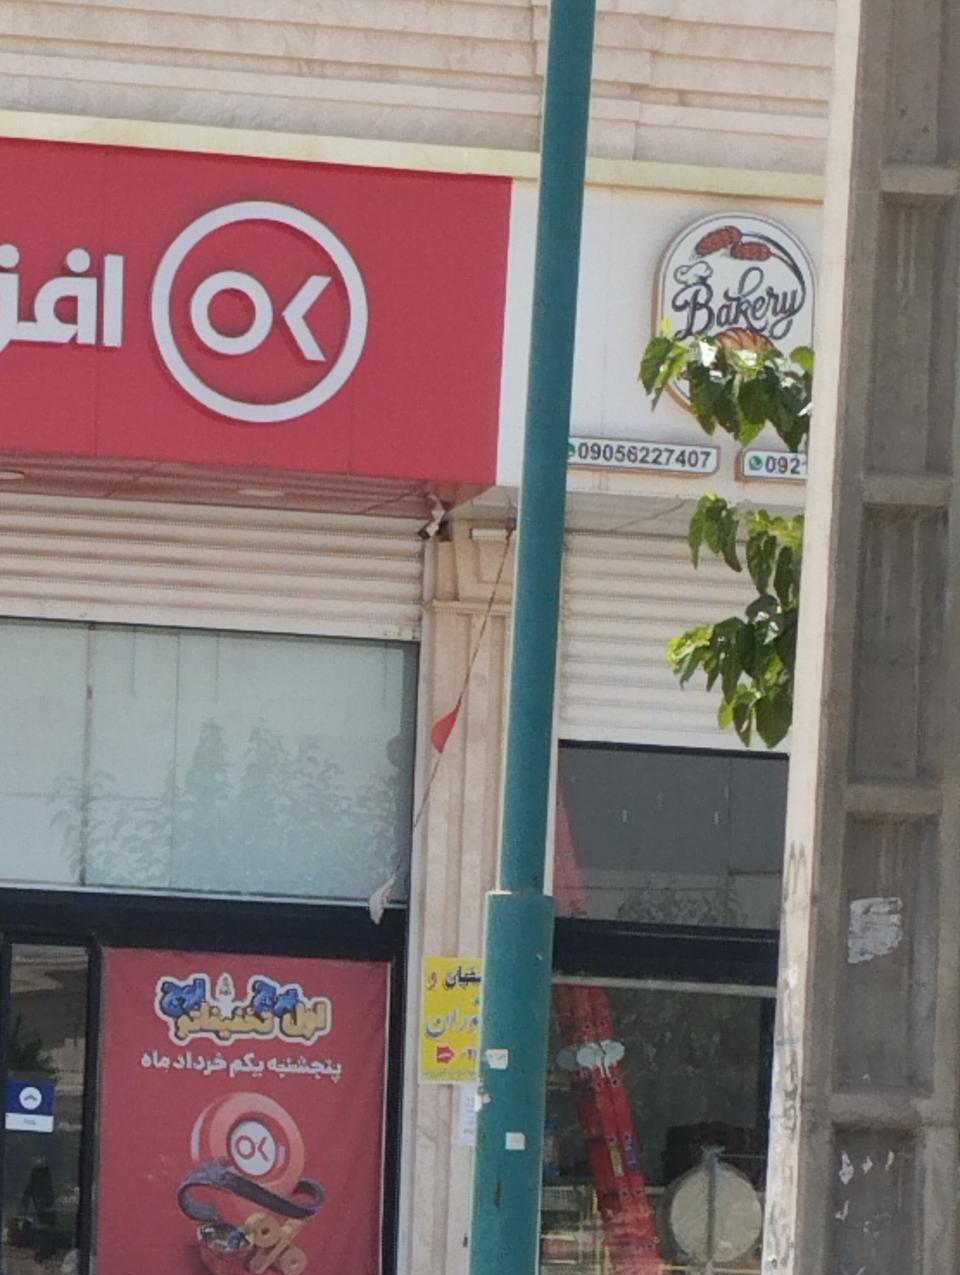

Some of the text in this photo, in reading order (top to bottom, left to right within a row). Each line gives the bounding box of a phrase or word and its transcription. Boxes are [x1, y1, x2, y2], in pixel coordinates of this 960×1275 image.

[671, 266, 806, 341] Bakery
[577, 442, 713, 469] 09056227407
[764, 452, 808, 475] 092
[140, 1050, 342, 1083] پنجشنبه یکم خرداد ماه
[235, 1134, 270, 1163] OK
